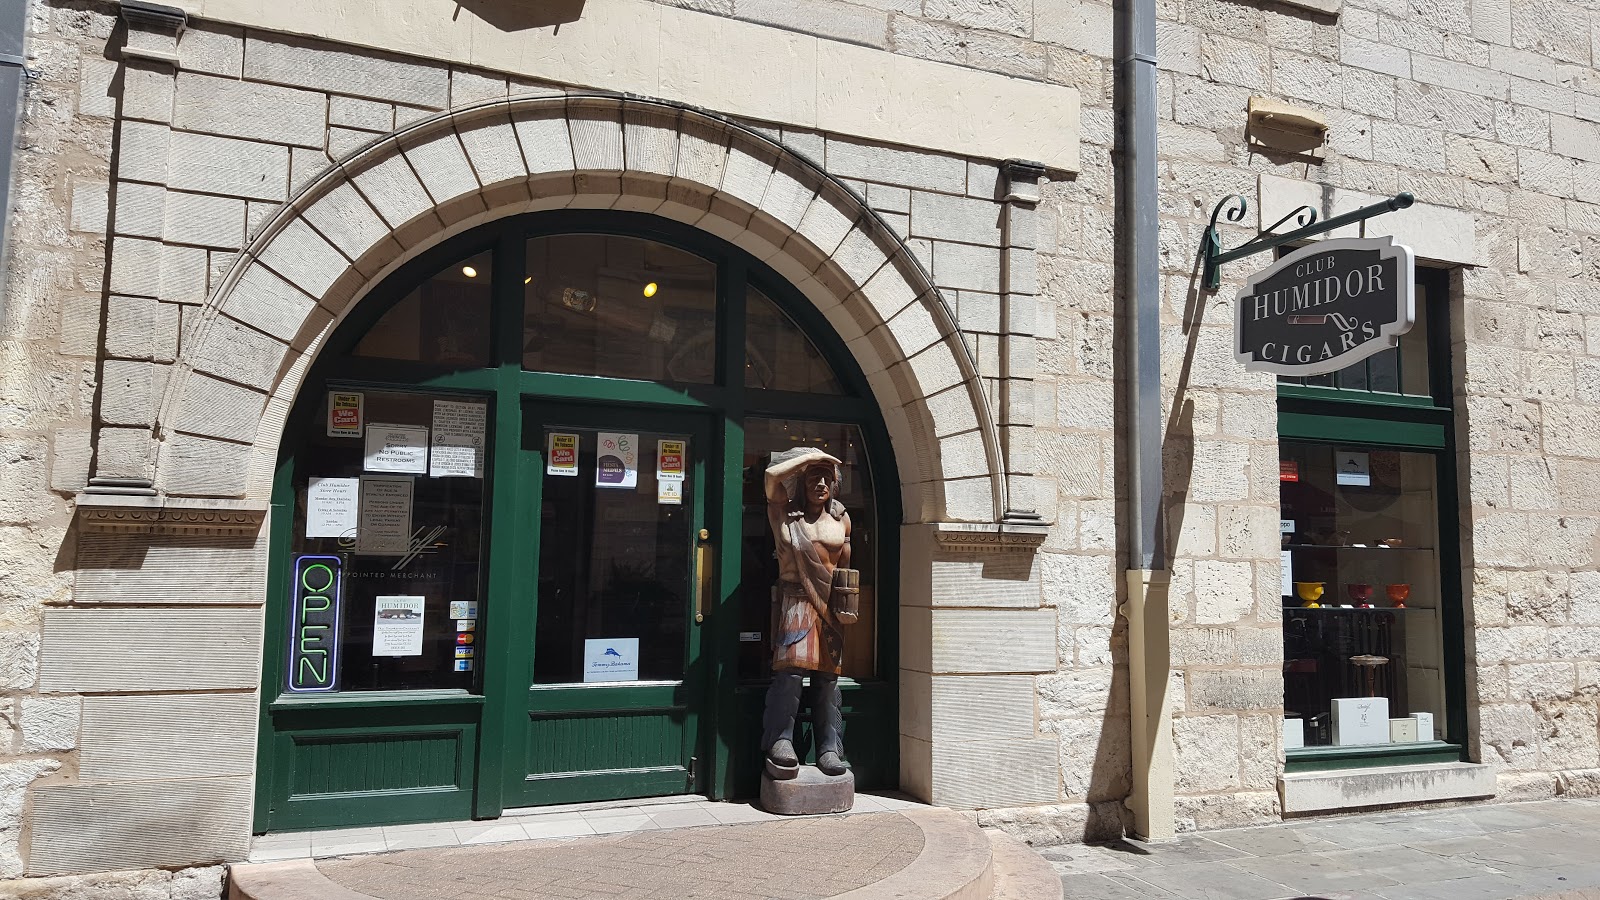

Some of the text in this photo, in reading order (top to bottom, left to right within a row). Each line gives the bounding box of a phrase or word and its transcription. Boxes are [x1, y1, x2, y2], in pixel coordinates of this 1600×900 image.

[1297, 255, 1335, 278] CLUB
[1253, 264, 1385, 321] HUMIDOR
[1261, 320, 1375, 363] CIGARS
[298, 563, 334, 684] OPEN
